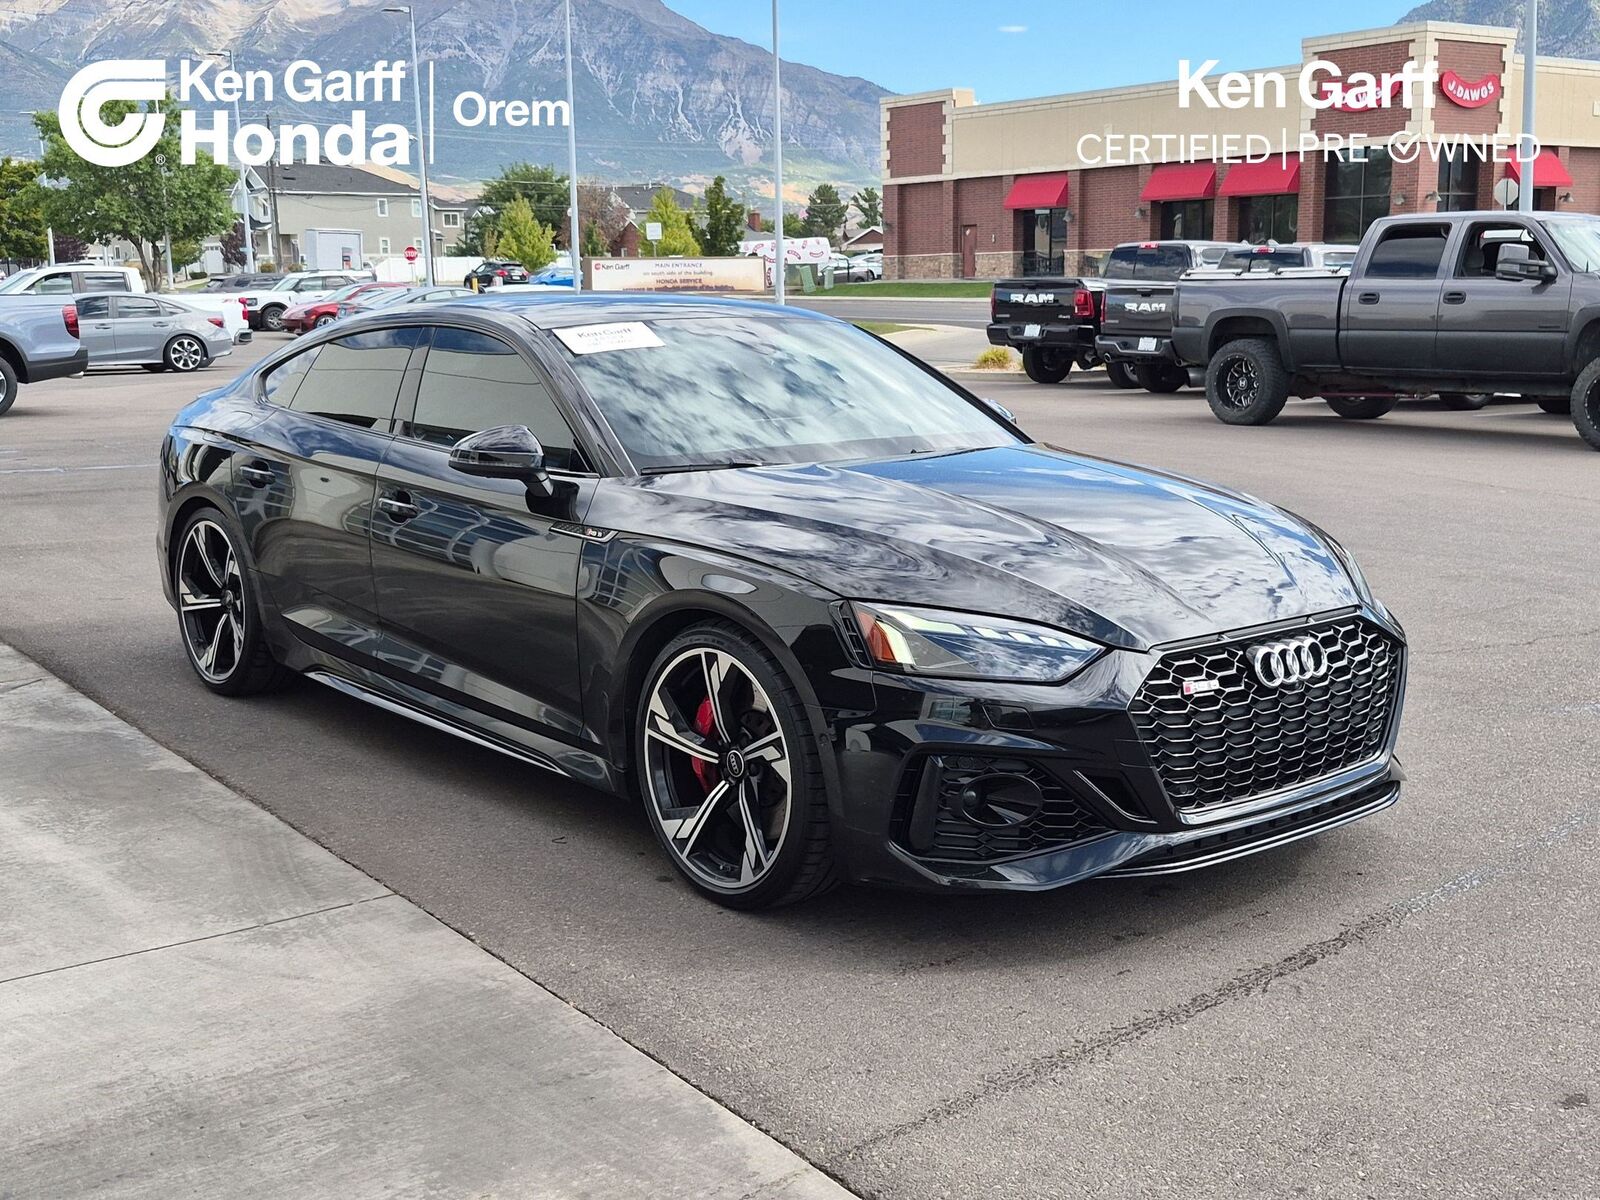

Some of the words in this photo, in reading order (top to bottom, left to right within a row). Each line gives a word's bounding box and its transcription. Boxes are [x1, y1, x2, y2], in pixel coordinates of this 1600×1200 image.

[1448, 80, 1494, 101] J.DAWGS
[1010, 293, 1054, 303] RAM
[1124, 302, 1166, 312] RAM
